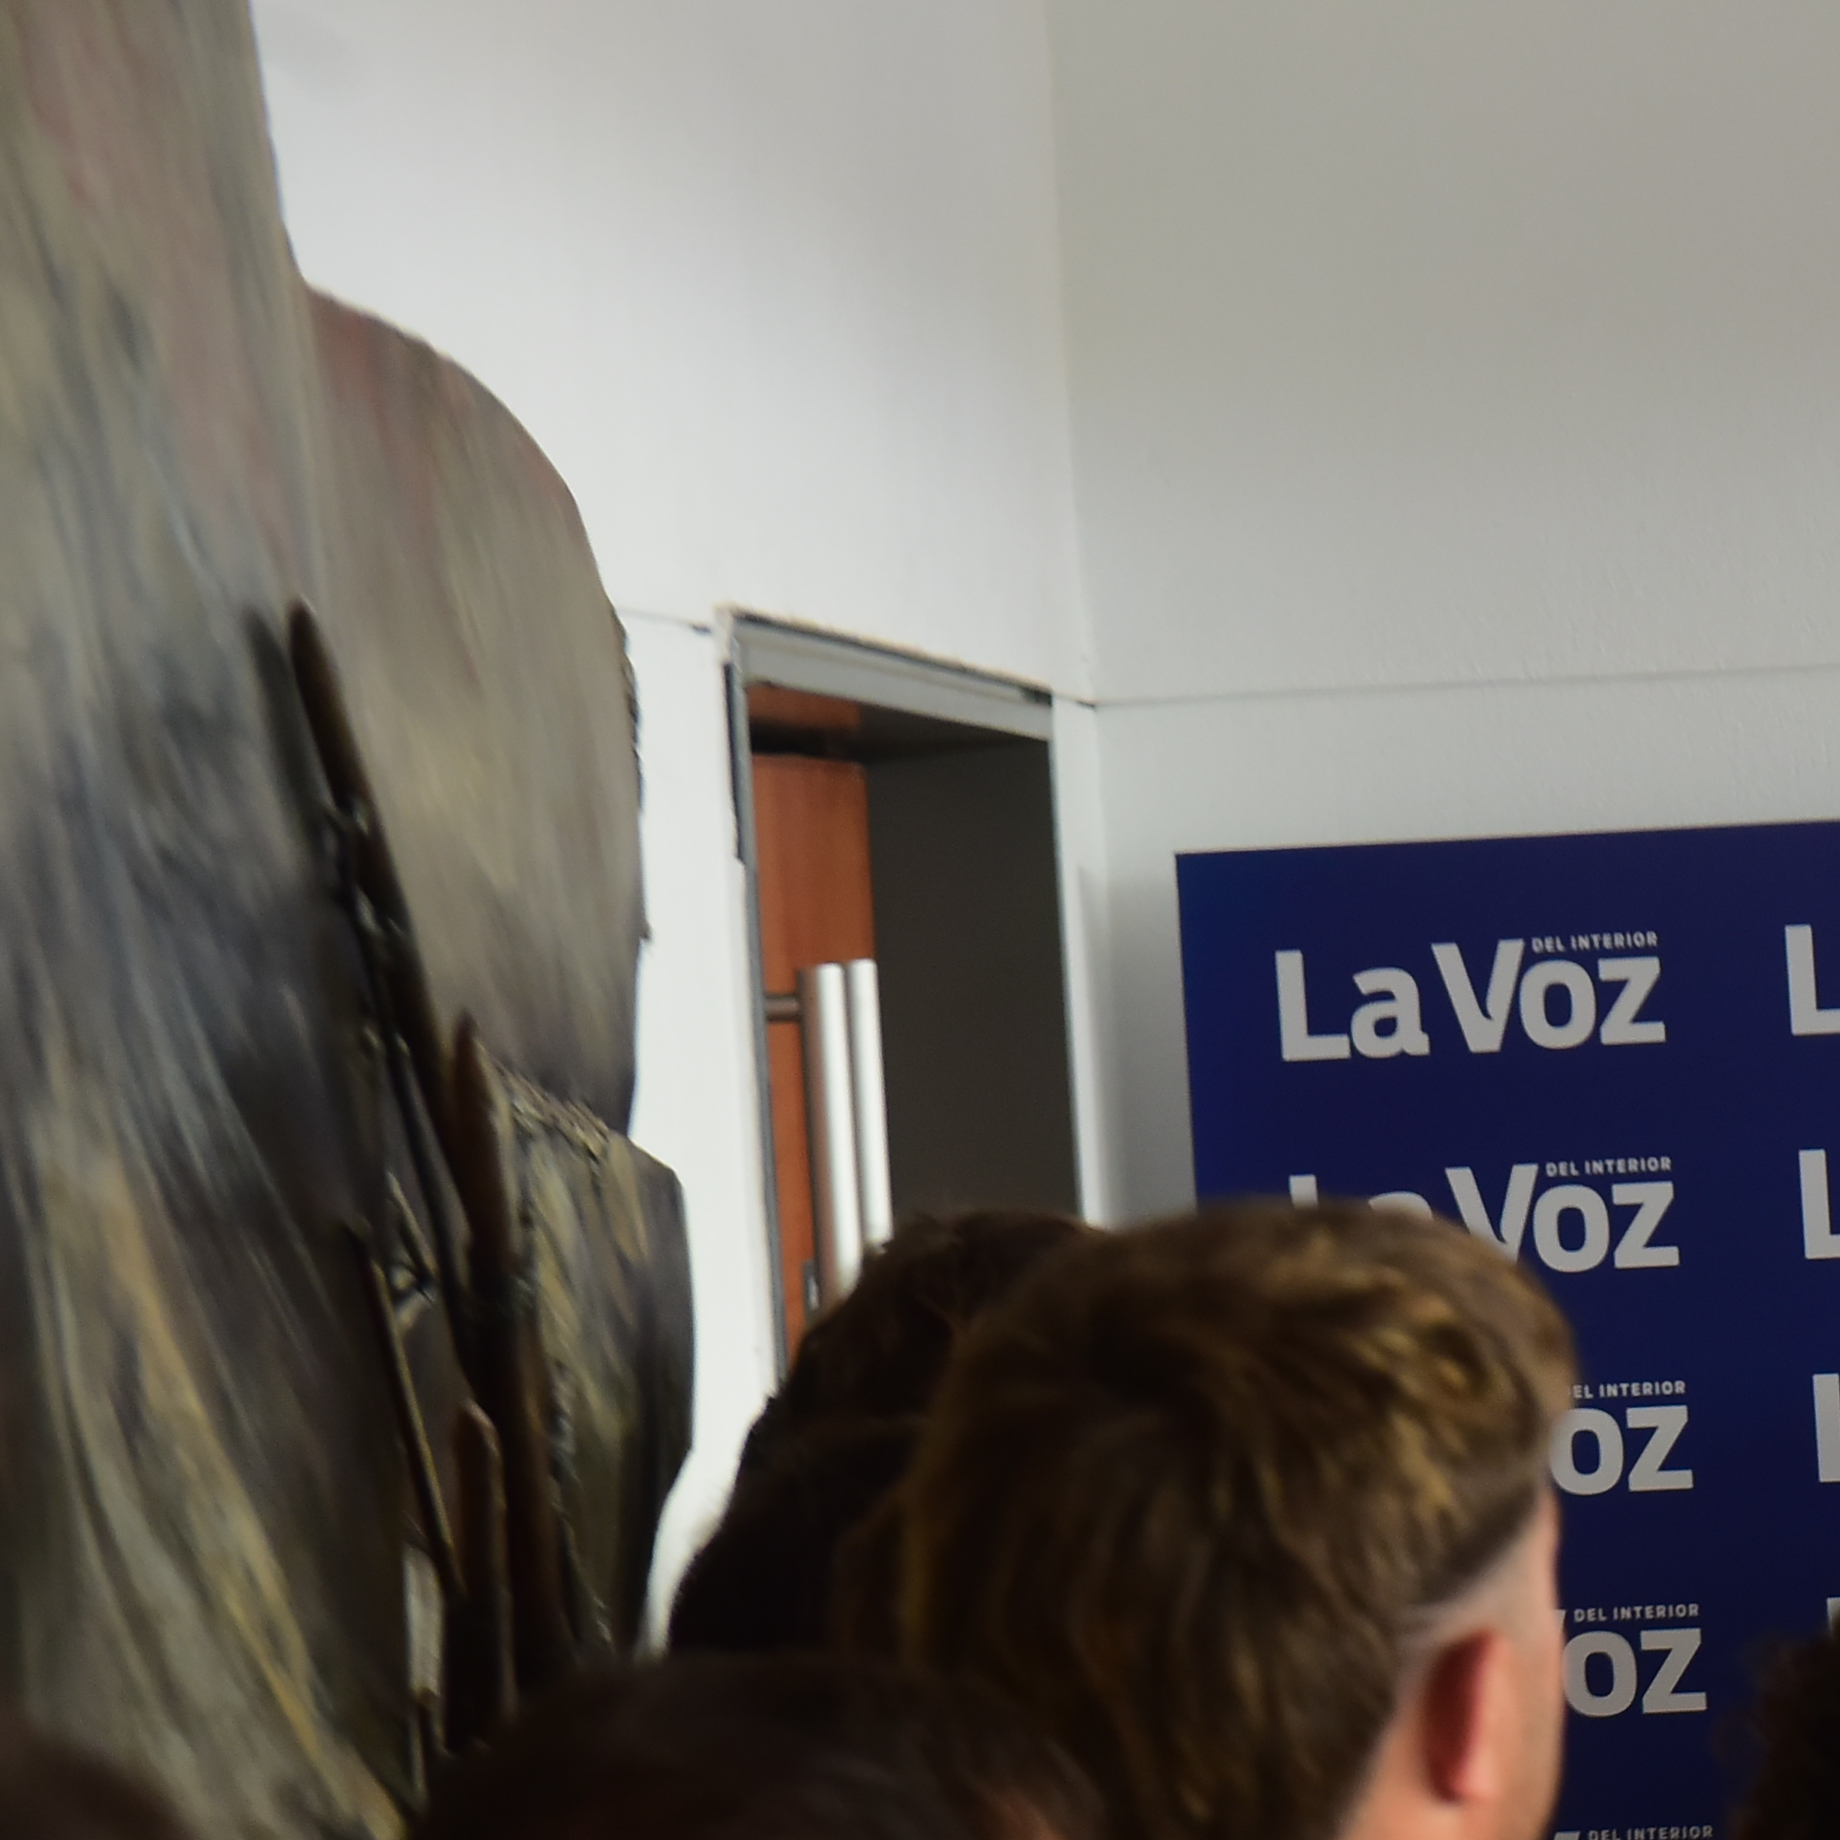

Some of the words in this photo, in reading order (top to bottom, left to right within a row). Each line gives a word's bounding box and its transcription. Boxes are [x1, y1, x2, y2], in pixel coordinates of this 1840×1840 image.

[1532, 937, 1564, 952] DEL
[1571, 932, 1655, 950] INTERIOR
[1546, 1162, 1578, 1177] DEL
[1585, 1157, 1671, 1174] INTERIOR
[1600, 1381, 1685, 1397] INTERIOR
[1553, 1405, 1693, 1496] oz
[1574, 1607, 1608, 1622] DEL
[1613, 1603, 1699, 1620] INTERIOR
[1558, 1610, 1707, 1717] oz
